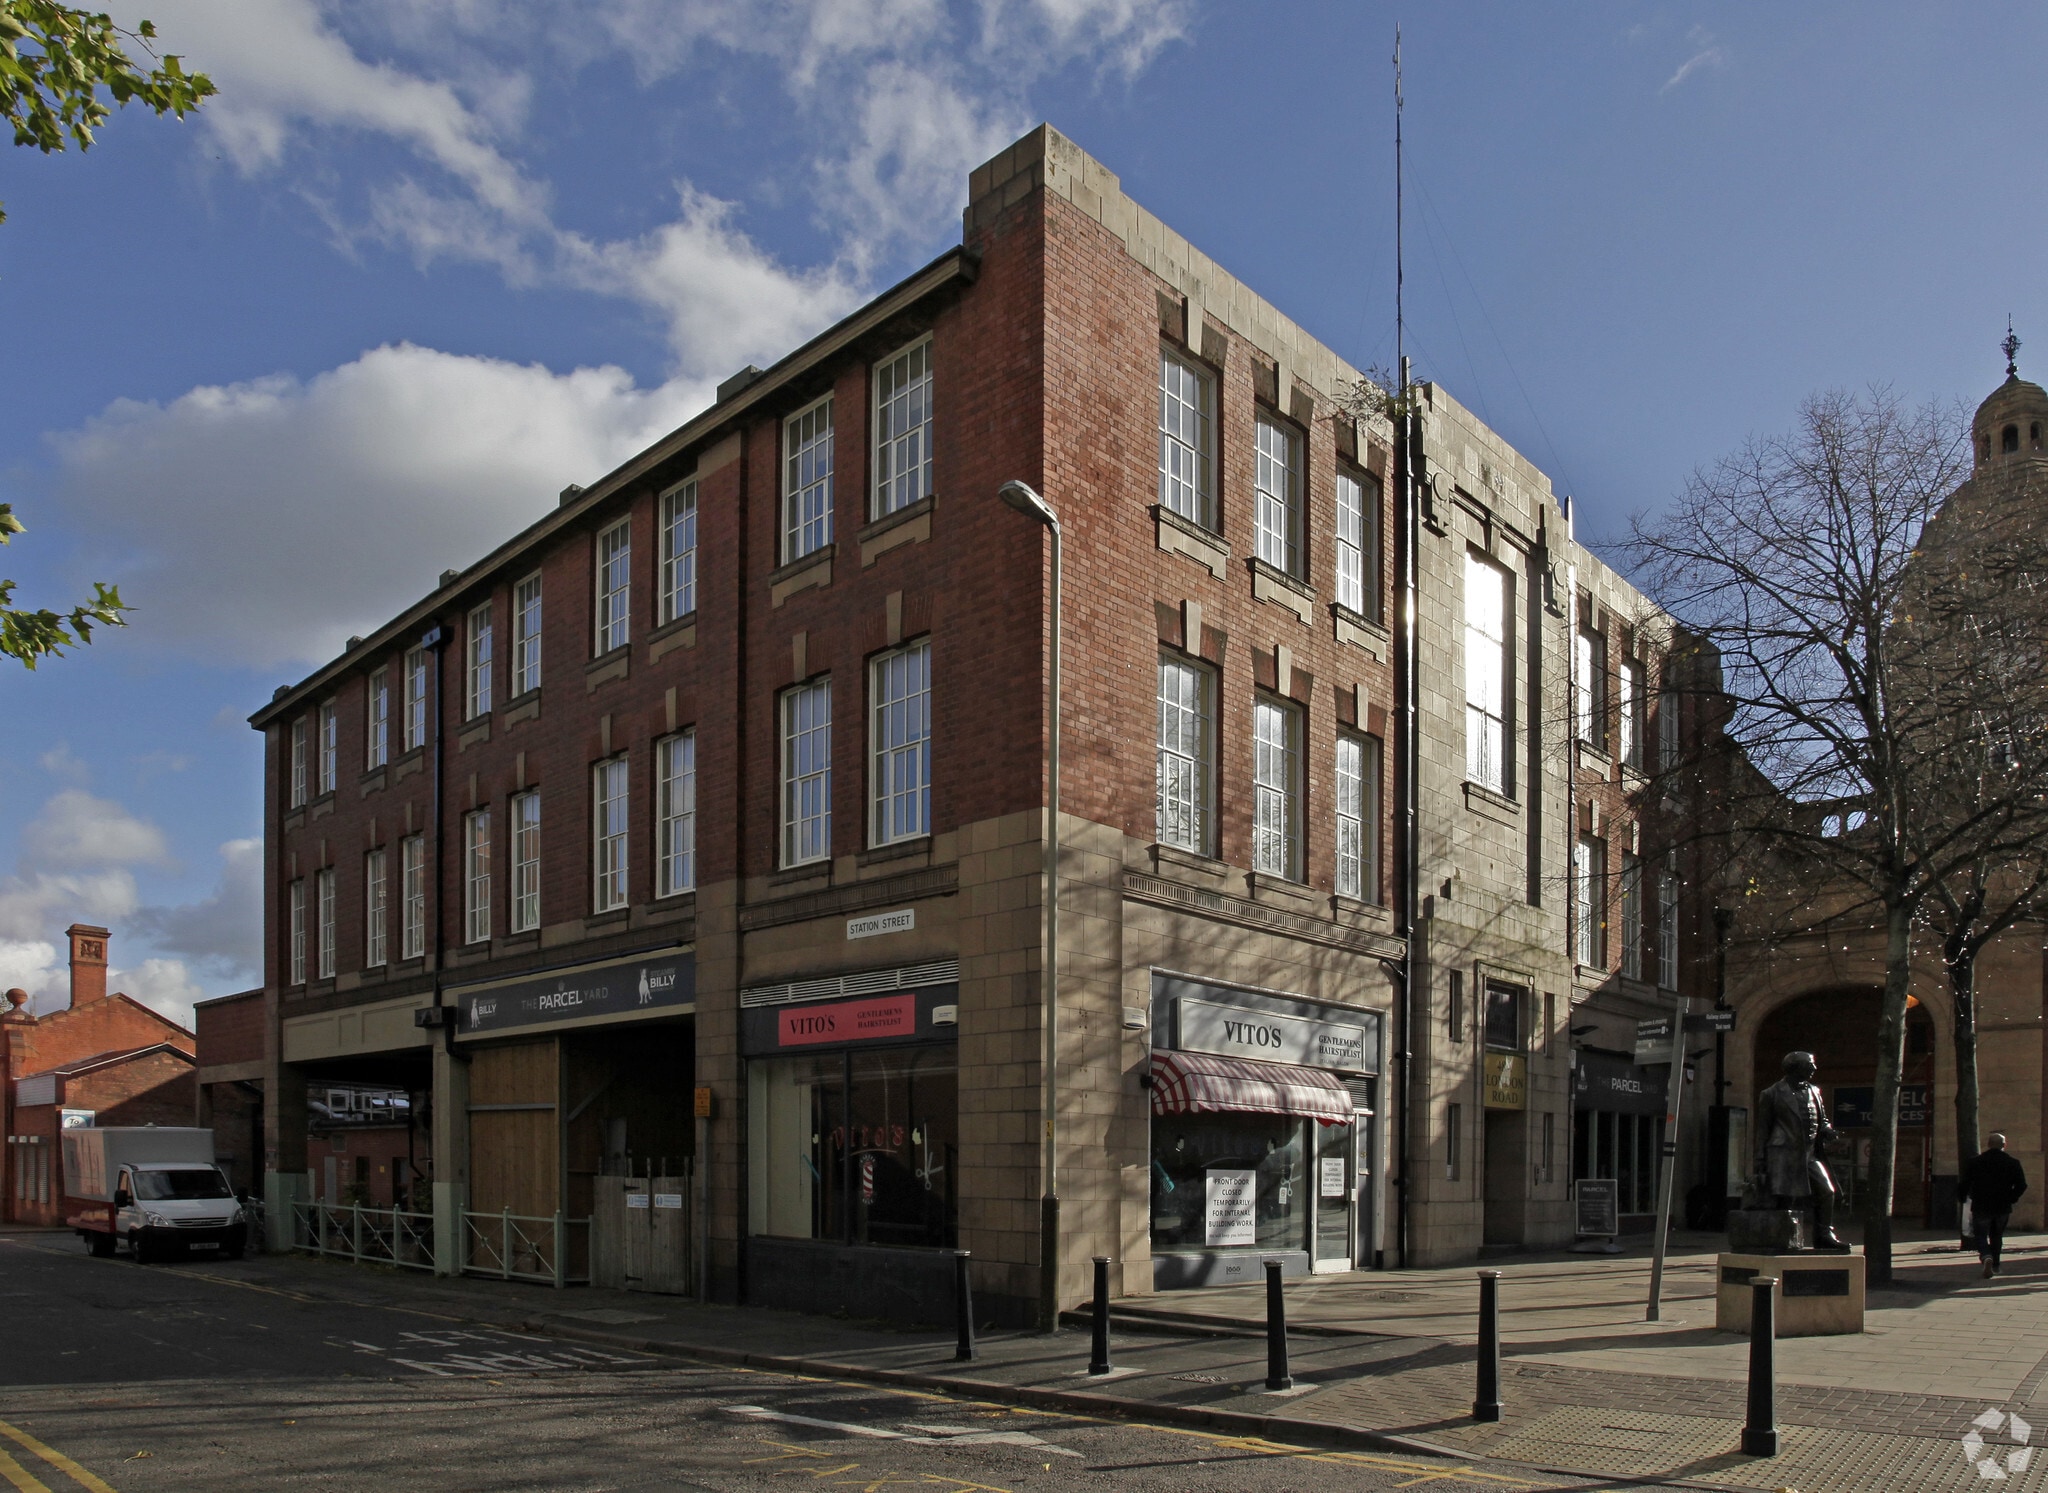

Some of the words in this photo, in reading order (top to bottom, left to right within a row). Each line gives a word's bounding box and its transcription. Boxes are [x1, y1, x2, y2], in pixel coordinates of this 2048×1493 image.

[850, 920, 879, 935] STATION
[882, 914, 911, 929] STREET
[650, 974, 676, 988] BILLY
[521, 998, 538, 1010] THE
[539, 990, 583, 1010] PARCEL
[583, 986, 609, 1002] YARD
[478, 1003, 496, 1014] BILLY
[857, 1008, 902, 1019] GENTLEMENS
[790, 1013, 835, 1035] VITO'S
[858, 1017, 902, 1029] HAIRSTYLIST
[1224, 1020, 1282, 1048] VITO'S
[1318, 1034, 1361, 1048] GENTLEMENS
[1319, 1044, 1361, 1059] HAIRSTYLIST
[1611, 1077, 1643, 1093] PARCEL
[1492, 1090, 1518, 1103] ROAD
[70, 1117, 79, 1125] To
[1208, 1220, 1235, 1228] BUILDING
